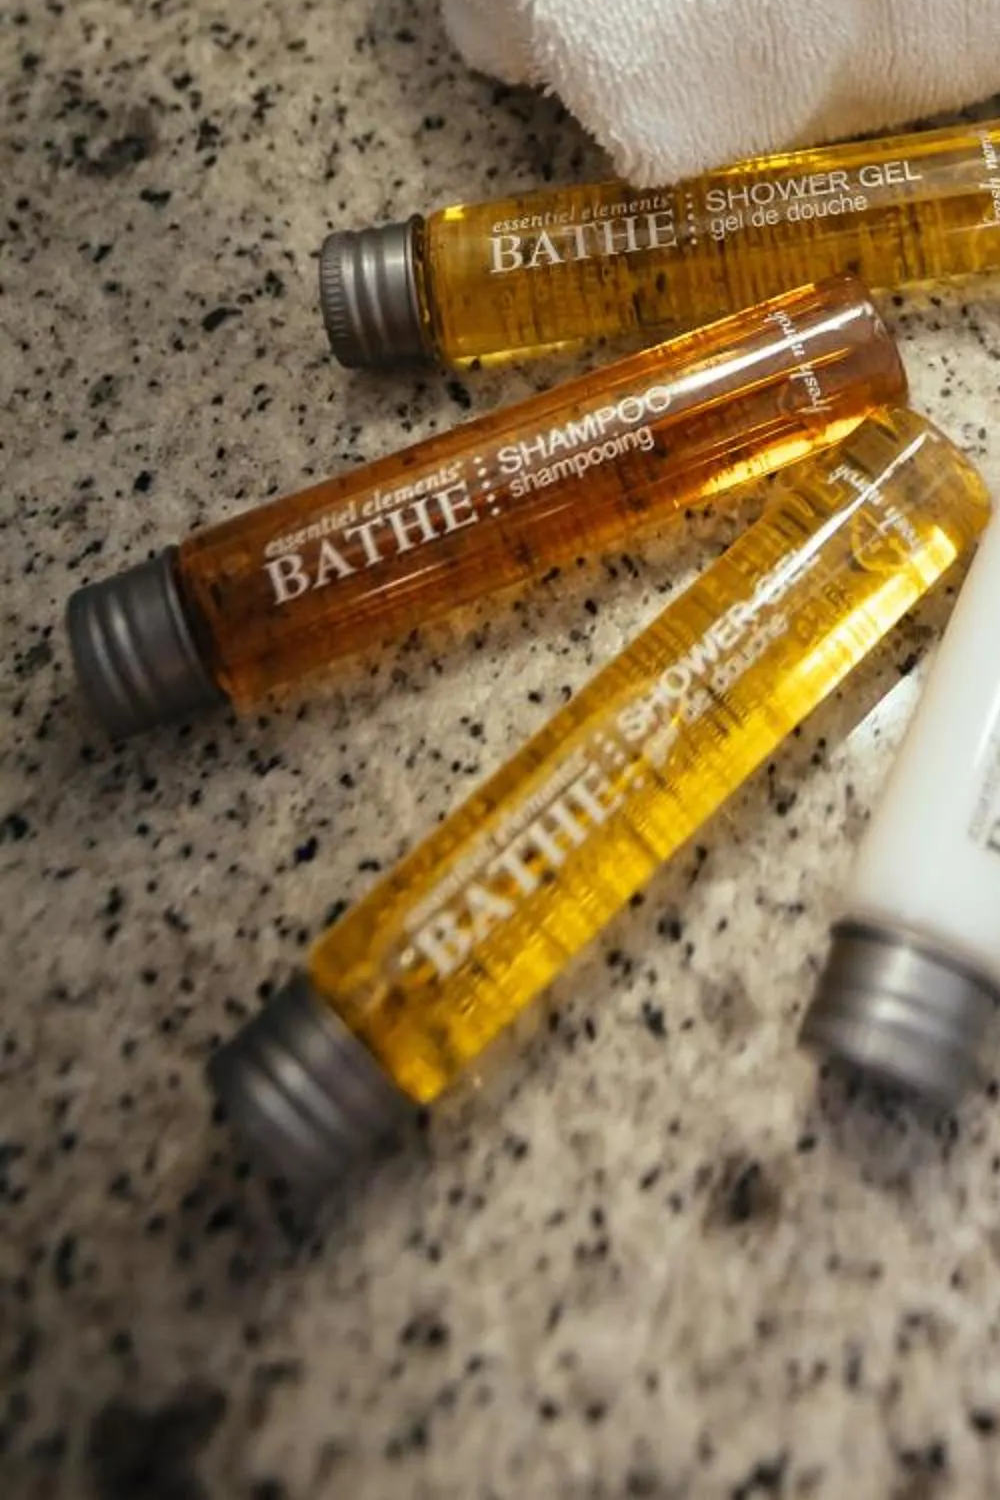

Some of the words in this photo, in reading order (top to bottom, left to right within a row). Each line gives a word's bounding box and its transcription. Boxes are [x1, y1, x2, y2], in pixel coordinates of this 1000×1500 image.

[704, 171, 851, 212] SHOWER
[858, 160, 923, 188] GEL
[710, 211, 745, 241] gel
[751, 205, 780, 228] de
[786, 193, 869, 222] douche
[487, 209, 678, 274] BATHE
[497, 385, 672, 474] SHAMPOO
[509, 424, 656, 498] shampooing
[262, 479, 480, 606] BATHE
[616, 602, 763, 743] SHOWER
[413, 760, 627, 978] BATHE
